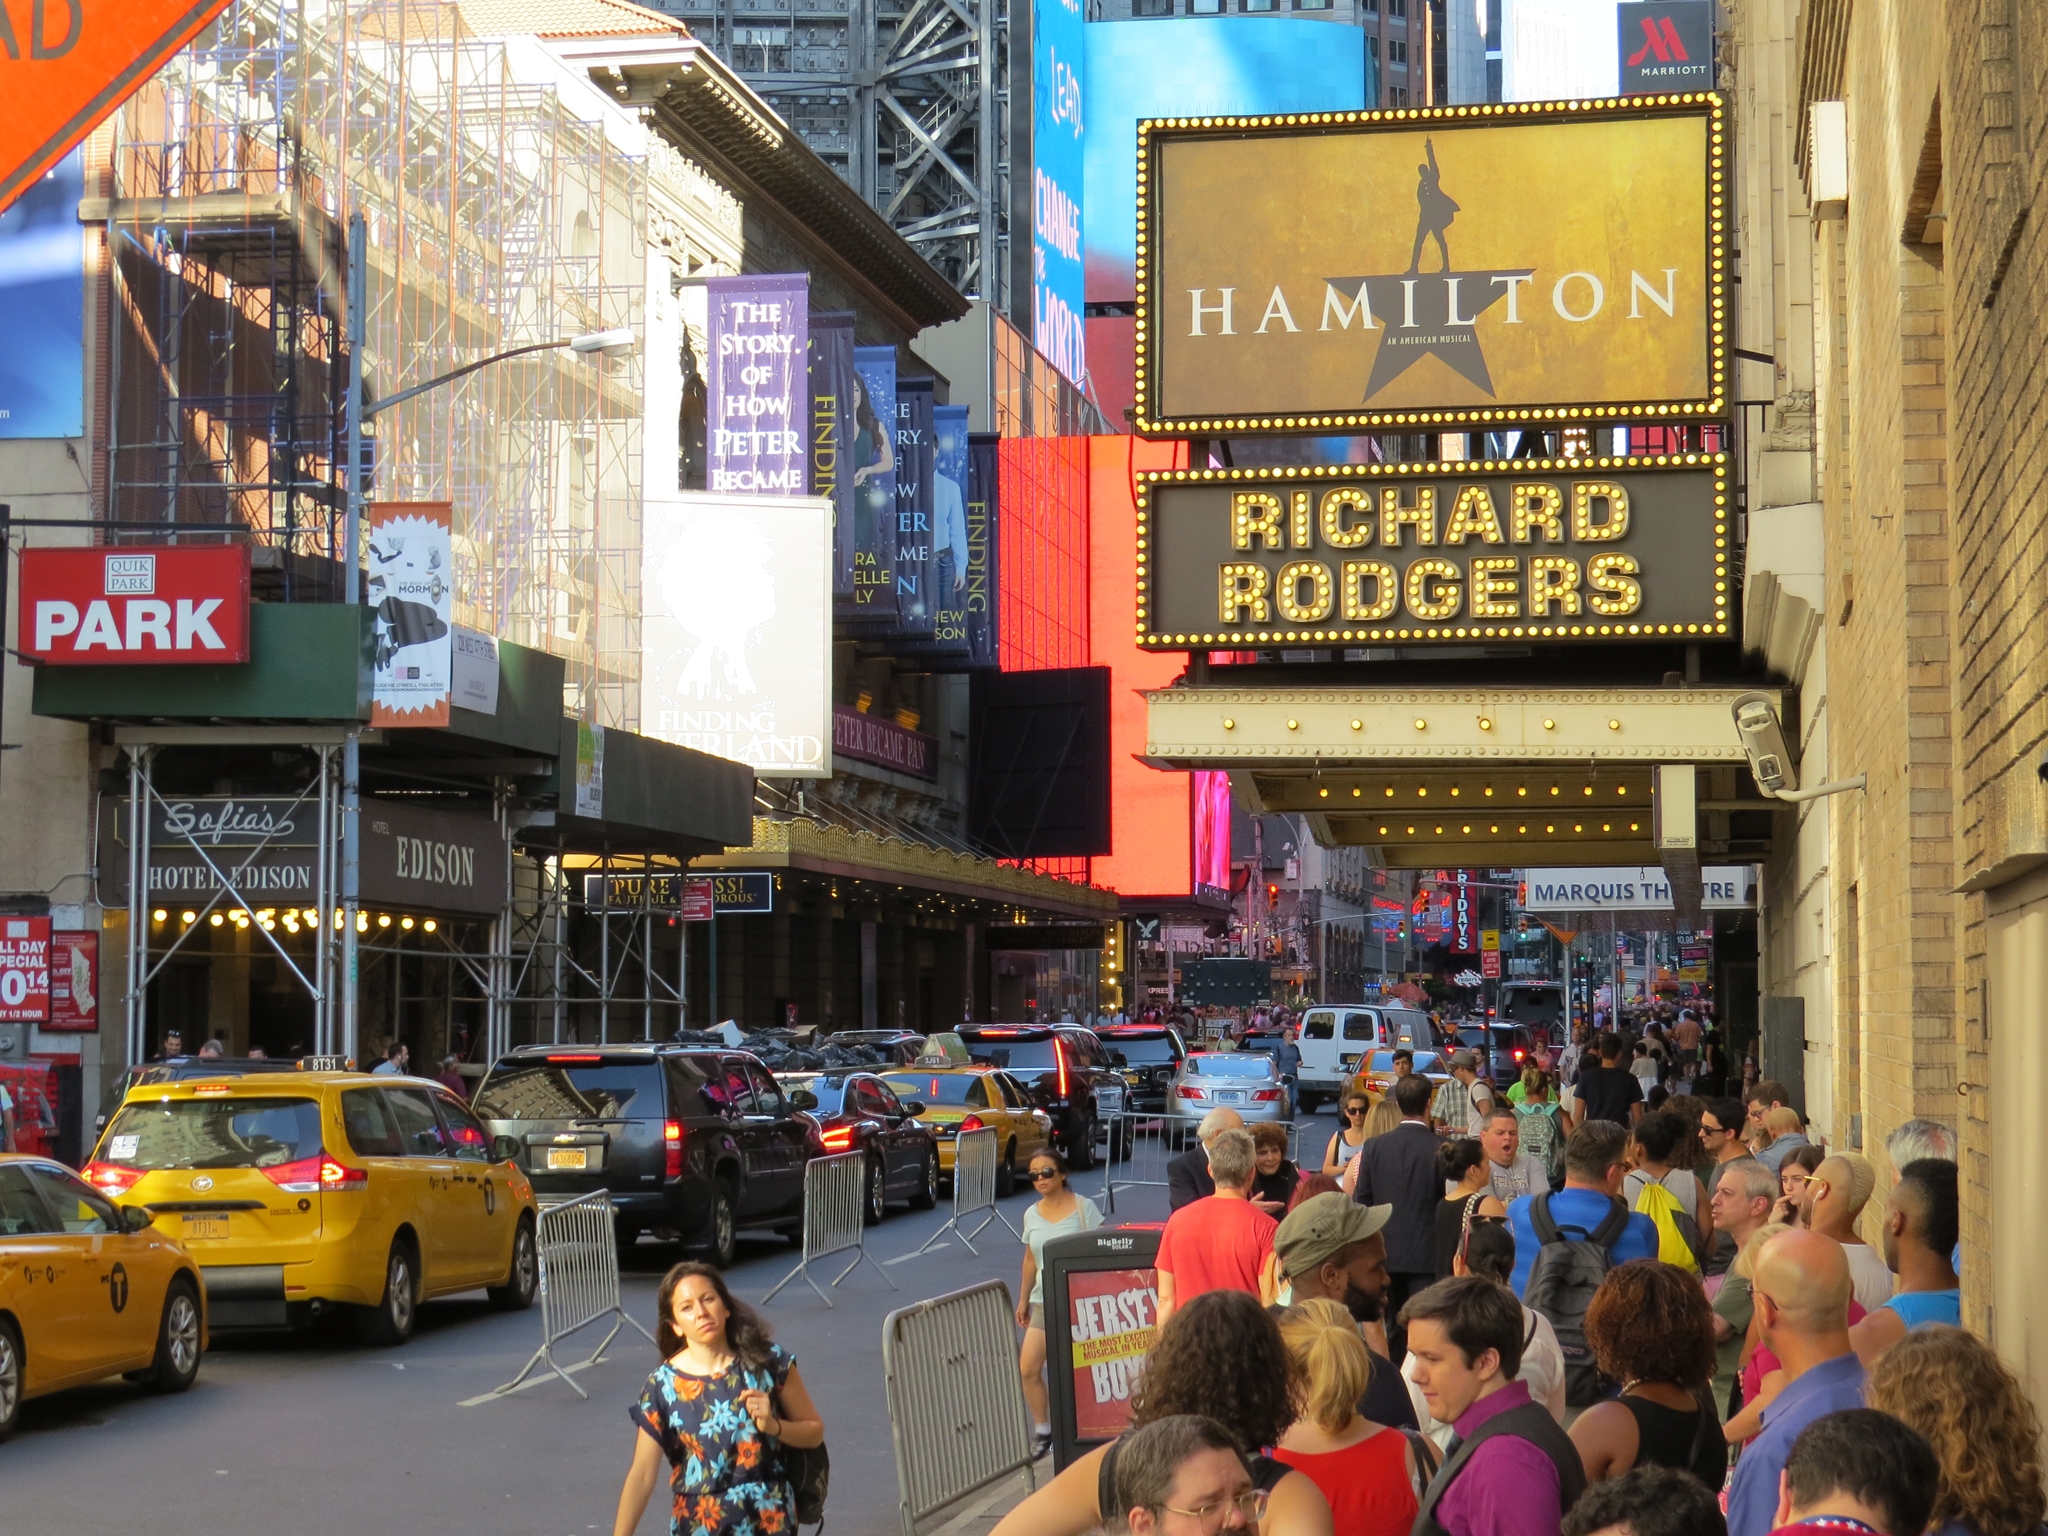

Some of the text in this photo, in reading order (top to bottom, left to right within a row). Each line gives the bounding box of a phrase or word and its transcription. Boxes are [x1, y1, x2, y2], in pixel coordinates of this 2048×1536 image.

[1641, 65, 1706, 76] MARRIOTT
[1035, 166, 1080, 262] CHANGE
[731, 302, 782, 323] THE
[1187, 268, 1678, 337] HAMILTON
[1034, 284, 1085, 392] WORLD
[1387, 334, 1471, 345] AN AMERICAN MUSICAL
[740, 366, 772, 386] OF
[726, 395, 790, 417] HOW
[713, 429, 804, 457] PETER
[814, 394, 837, 528] FINDIN
[711, 469, 802, 491] BECAME
[1231, 480, 1630, 551] RICHARD
[111, 560, 149, 573] QUIK
[967, 501, 986, 613] FINDING
[111, 578, 149, 590] PARK
[1218, 551, 1643, 623] RODGERS
[35, 599, 226, 651] PARK
[658, 709, 776, 733] FINDING
[866, 722, 904, 764] BECAME
[164, 801, 294, 844] Sofia's
[372, 821, 389, 834] HOTEL
[397, 836, 474, 886] EDISON
[150, 866, 310, 889] HOTEL EDISON
[1535, 882, 1735, 904] MARQUIS THTRE
[20, 941, 47, 953] DAY
[10, 1010, 20, 1018] 1/2
[22, 1010, 43, 1018] HOUR
[312, 1058, 337, 1071] 8T31
[1097, 1237, 1134, 1247] BigBelly
[1083, 1348, 1120, 1361] MUSICAL
[1122, 1343, 1131, 1353] IN
[1099, 1336, 1121, 1347] MOST
[1092, 1354, 1147, 1403] BOY
